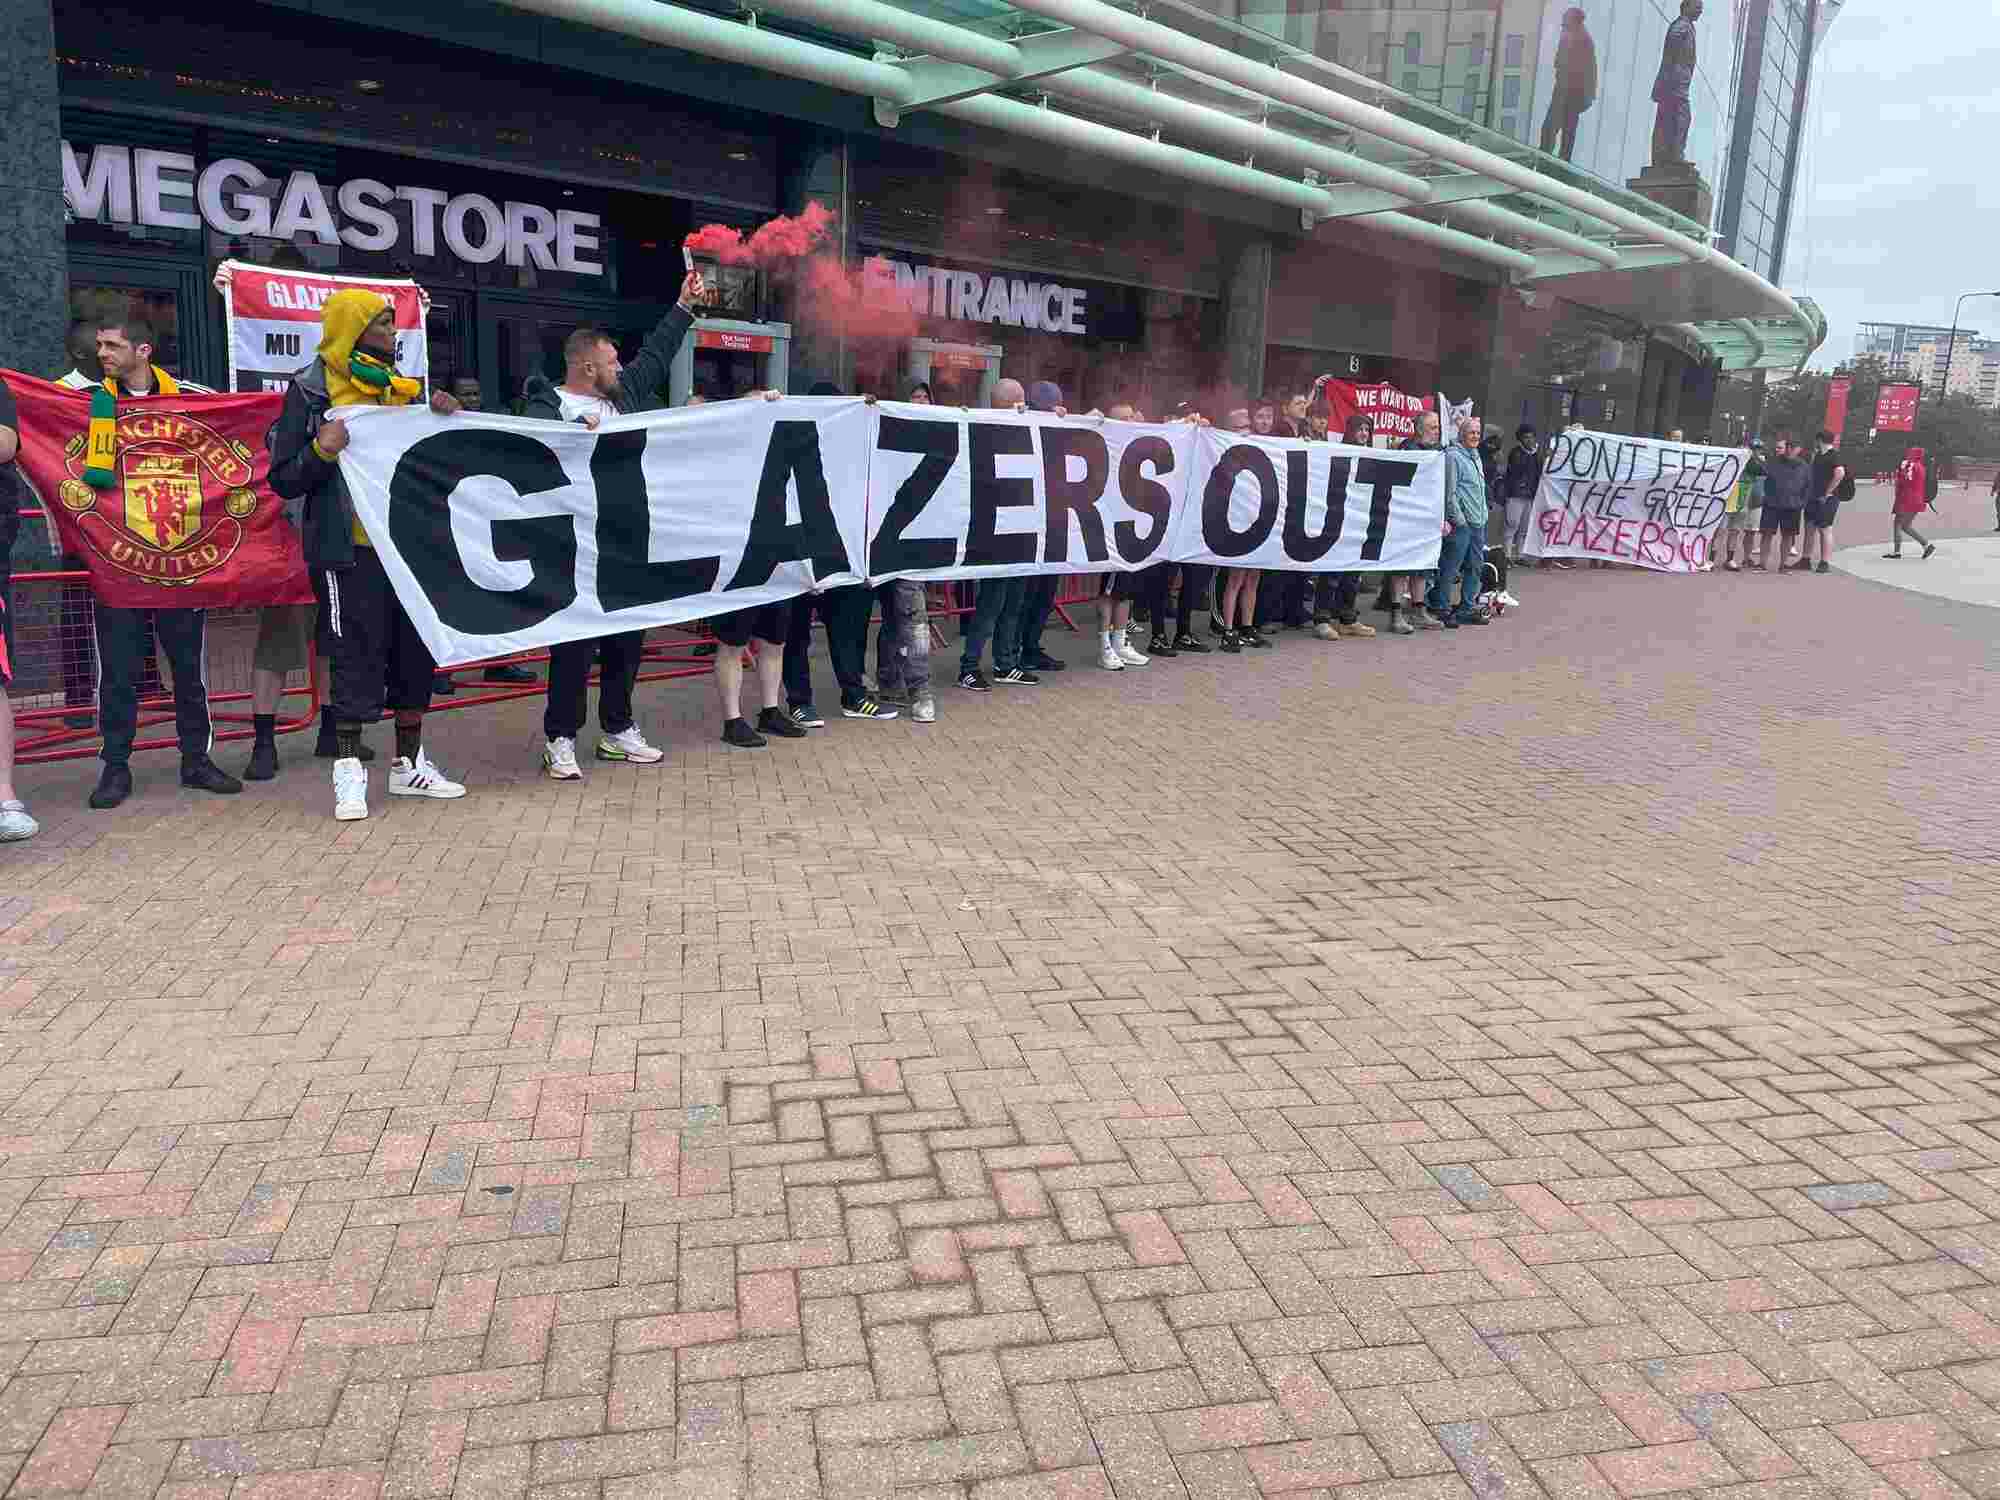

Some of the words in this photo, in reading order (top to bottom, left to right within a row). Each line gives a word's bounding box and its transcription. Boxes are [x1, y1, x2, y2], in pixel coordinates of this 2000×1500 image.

[60, 138, 603, 276] MEGASTORE
[1357, 390, 1378, 407] WE
[1381, 389, 1405, 411] WANT
[1650, 448, 1740, 494] FEED
[388, 418, 1176, 636] GLAZERS
[1201, 444, 1418, 562] OUT
[1562, 478, 1636, 518] THE
[1644, 487, 1727, 530] GREED
[111, 540, 219, 574] UNITED
[1538, 508, 1676, 566] GLAZERS
